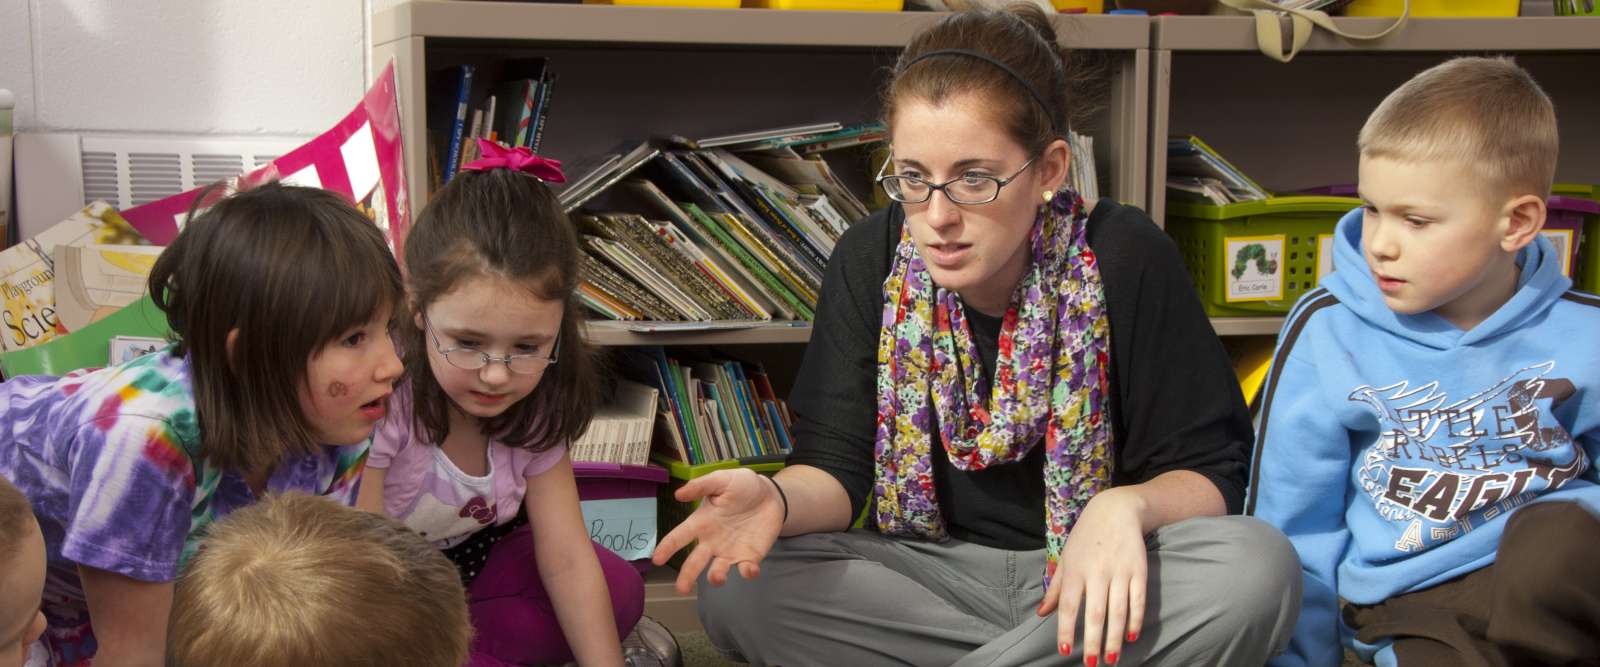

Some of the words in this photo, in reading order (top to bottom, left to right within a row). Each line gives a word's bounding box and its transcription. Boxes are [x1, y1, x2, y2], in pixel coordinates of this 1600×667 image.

[1, 270, 56, 299] Playgroun
[3, 305, 56, 346] Scie
[591, 519, 649, 552] Books
